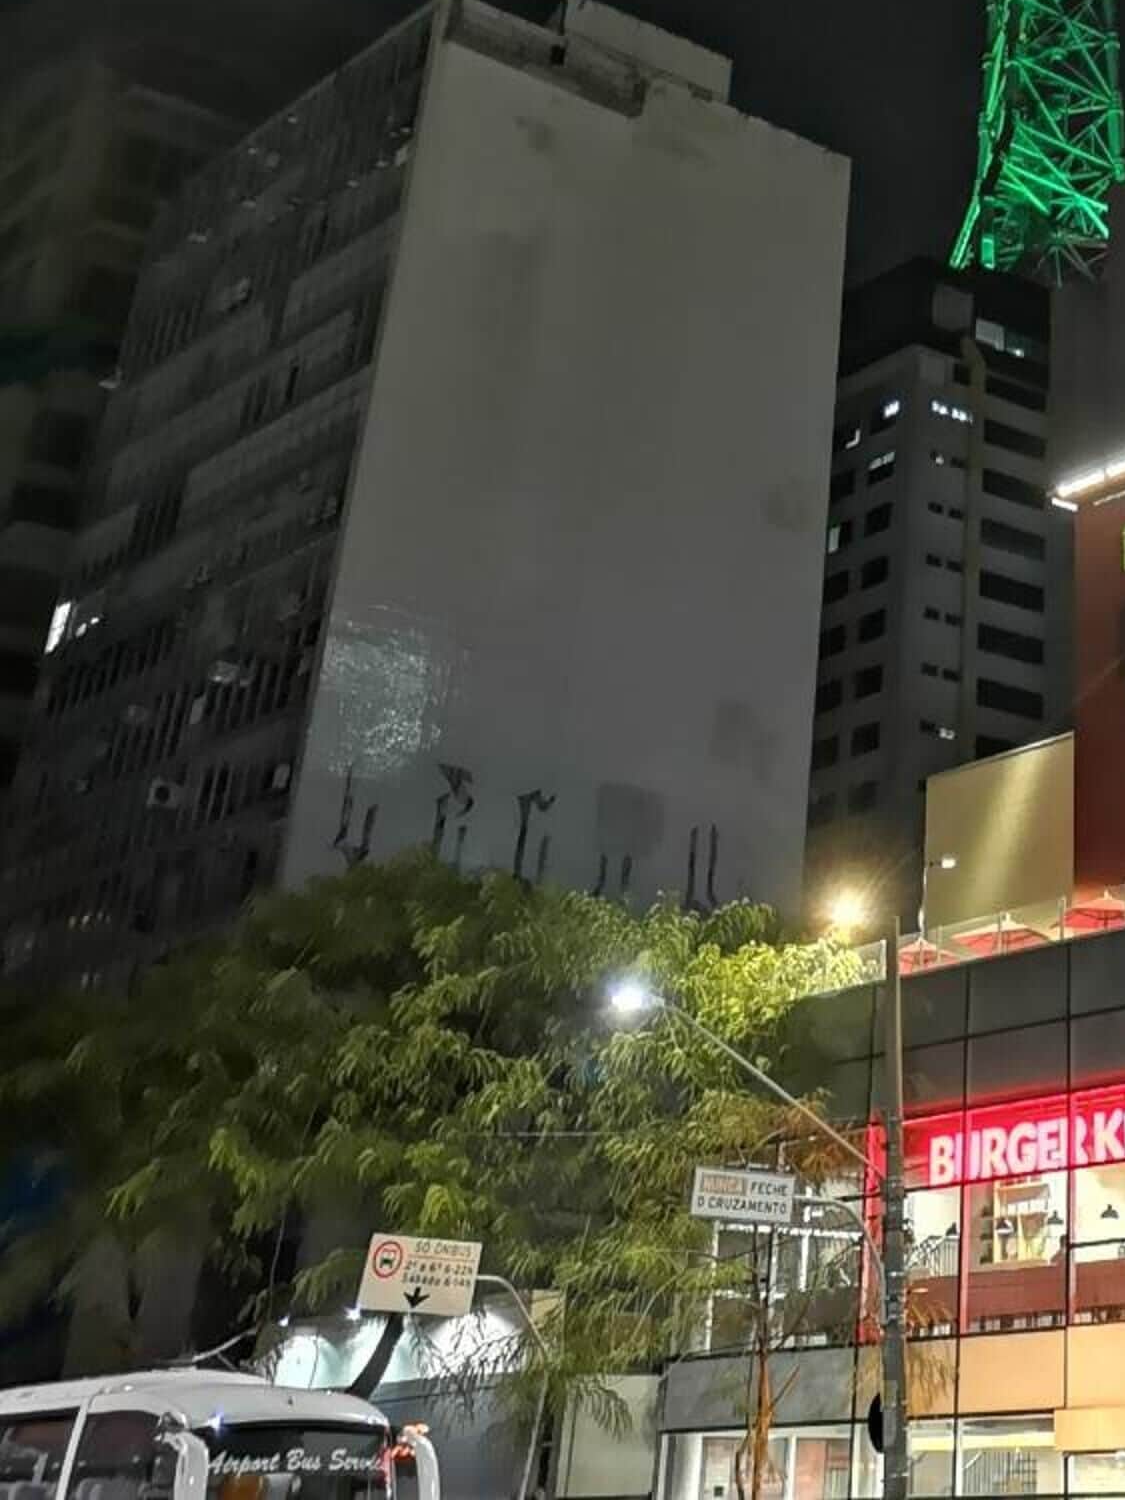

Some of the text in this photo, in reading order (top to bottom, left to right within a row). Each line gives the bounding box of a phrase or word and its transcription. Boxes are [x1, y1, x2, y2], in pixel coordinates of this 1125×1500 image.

[928, 1115, 1088, 1185] BURGER
[751, 1181, 789, 1197] FECHE
[708, 1196, 786, 1214] CRUZAMENTO
[208, 1451, 281, 1478] Airport
[286, 1449, 321, 1472] Bus
